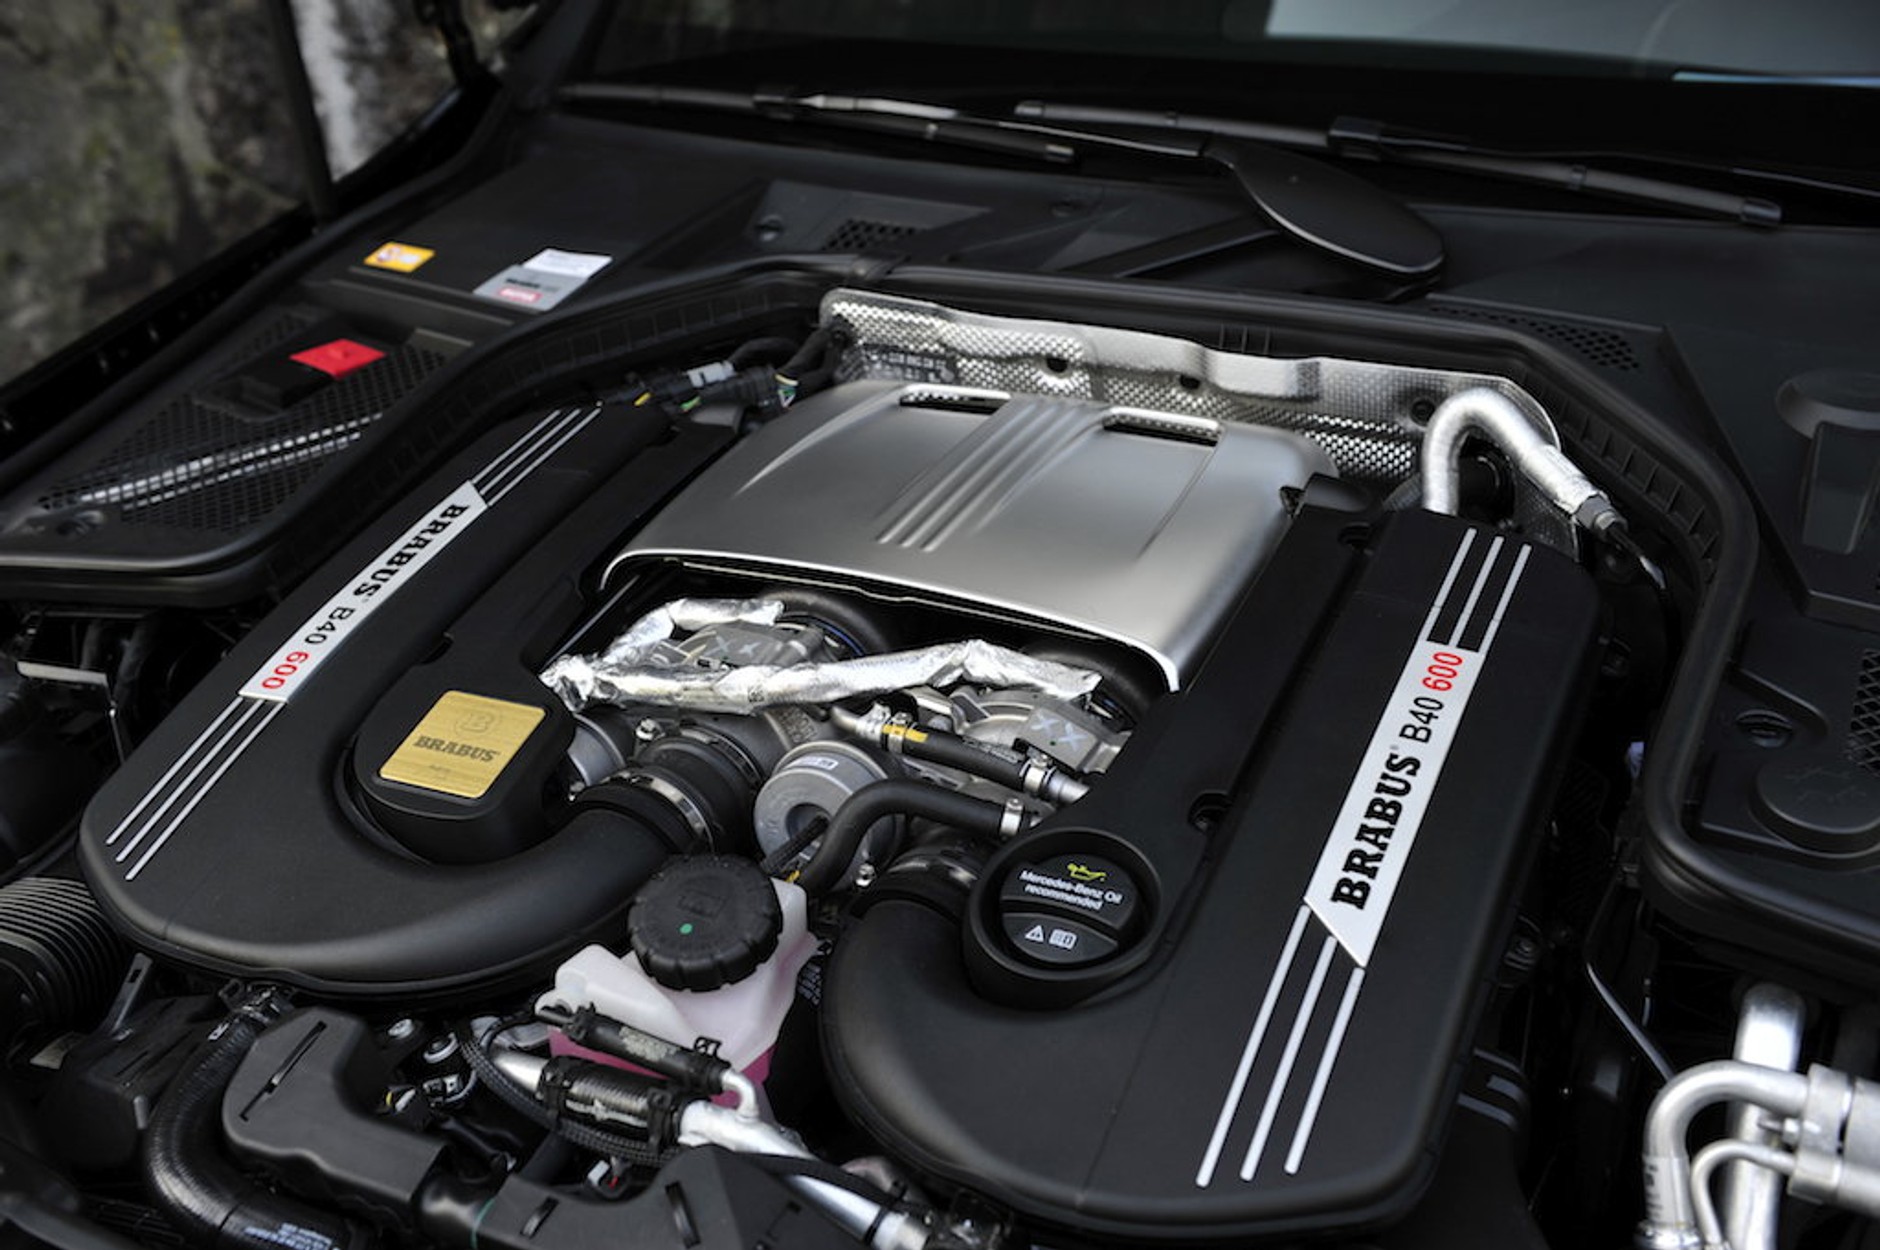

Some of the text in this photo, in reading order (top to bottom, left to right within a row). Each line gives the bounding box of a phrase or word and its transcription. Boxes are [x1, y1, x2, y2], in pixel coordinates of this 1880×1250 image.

[262, 504, 470, 689] BRABUS B40 600
[413, 735, 496, 762] BRABUS
[1331, 651, 1463, 910] BRABUS B40 600
[1019, 870, 1123, 904] Mercedes-Benz Oil
[1025, 884, 1103, 911] recommended
